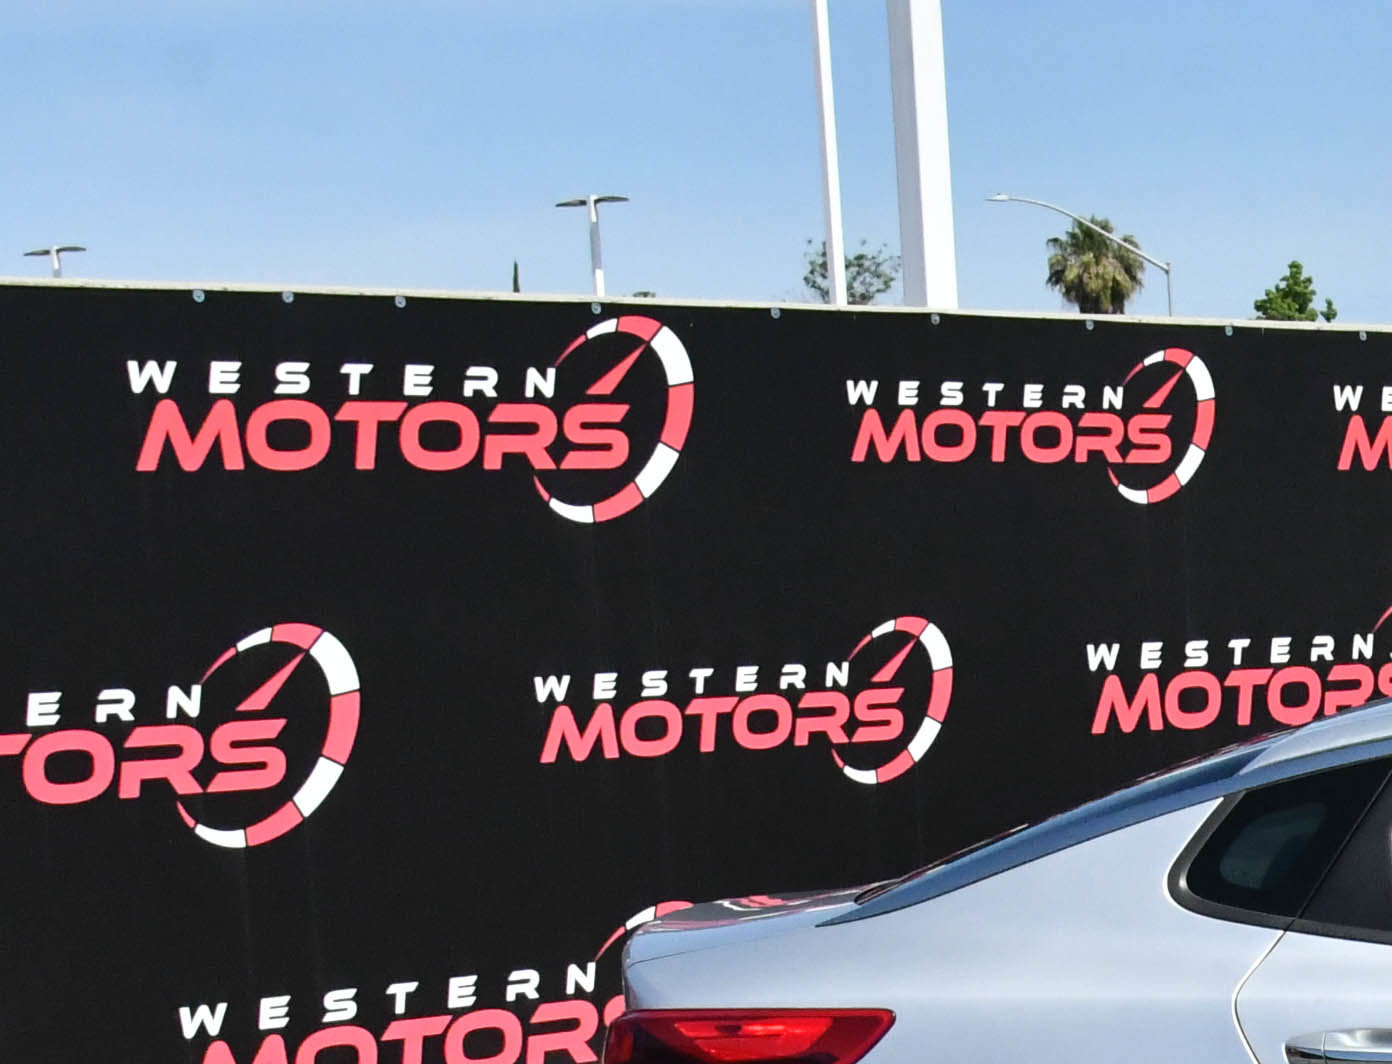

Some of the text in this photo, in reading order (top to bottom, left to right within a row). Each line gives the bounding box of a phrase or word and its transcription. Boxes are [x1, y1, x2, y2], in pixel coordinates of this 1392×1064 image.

[127, 359, 557, 399] WESTERN
[846, 379, 1125, 410] WESTERN
[135, 398, 630, 473] MOTORS
[851, 407, 1173, 464] MOTORS
[1087, 633, 1374, 672] WESTERN
[533, 661, 850, 704] WESTERN
[26, 684, 202, 727] ERN
[539, 687, 905, 764] MOTORS
[178, 961, 597, 1040] WESTERN
